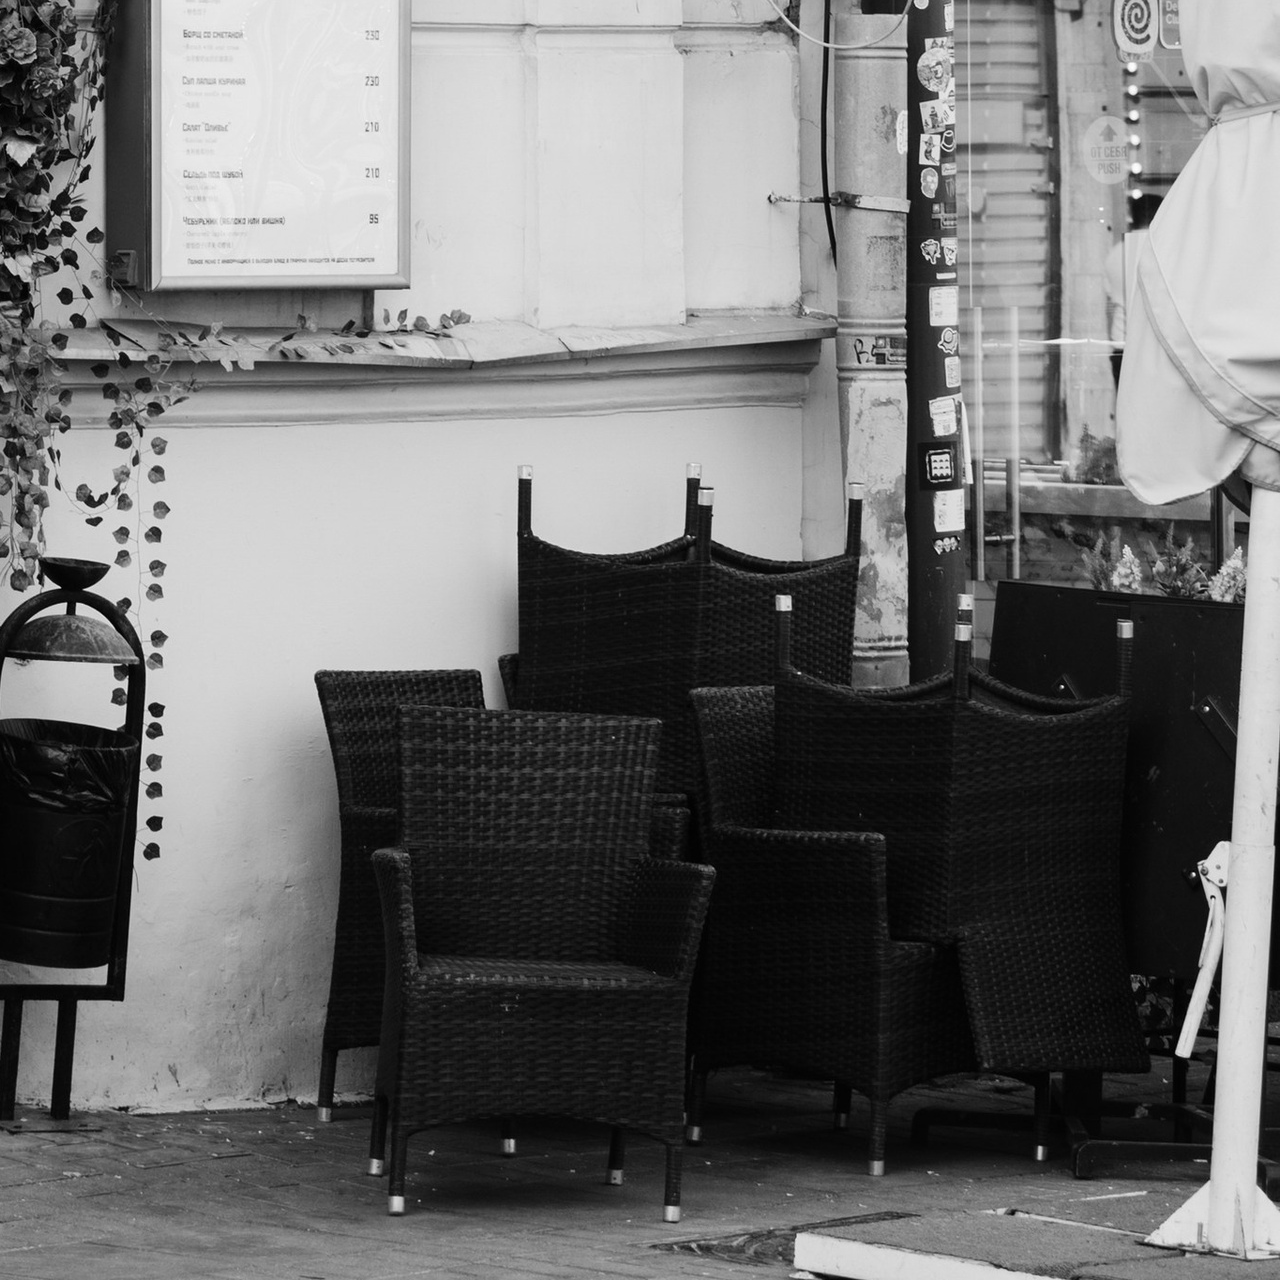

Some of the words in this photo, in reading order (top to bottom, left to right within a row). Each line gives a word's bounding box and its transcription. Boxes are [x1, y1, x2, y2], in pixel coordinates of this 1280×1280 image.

[365, 30, 380, 41] 230
[365, 76, 380, 87] 230
[364, 121, 379, 133] 210
[1104, 145, 1128, 158] СЕБЯ
[365, 167, 380, 178] 210
[1097, 162, 1121, 175] PUSH
[369, 213, 379, 225] 95
